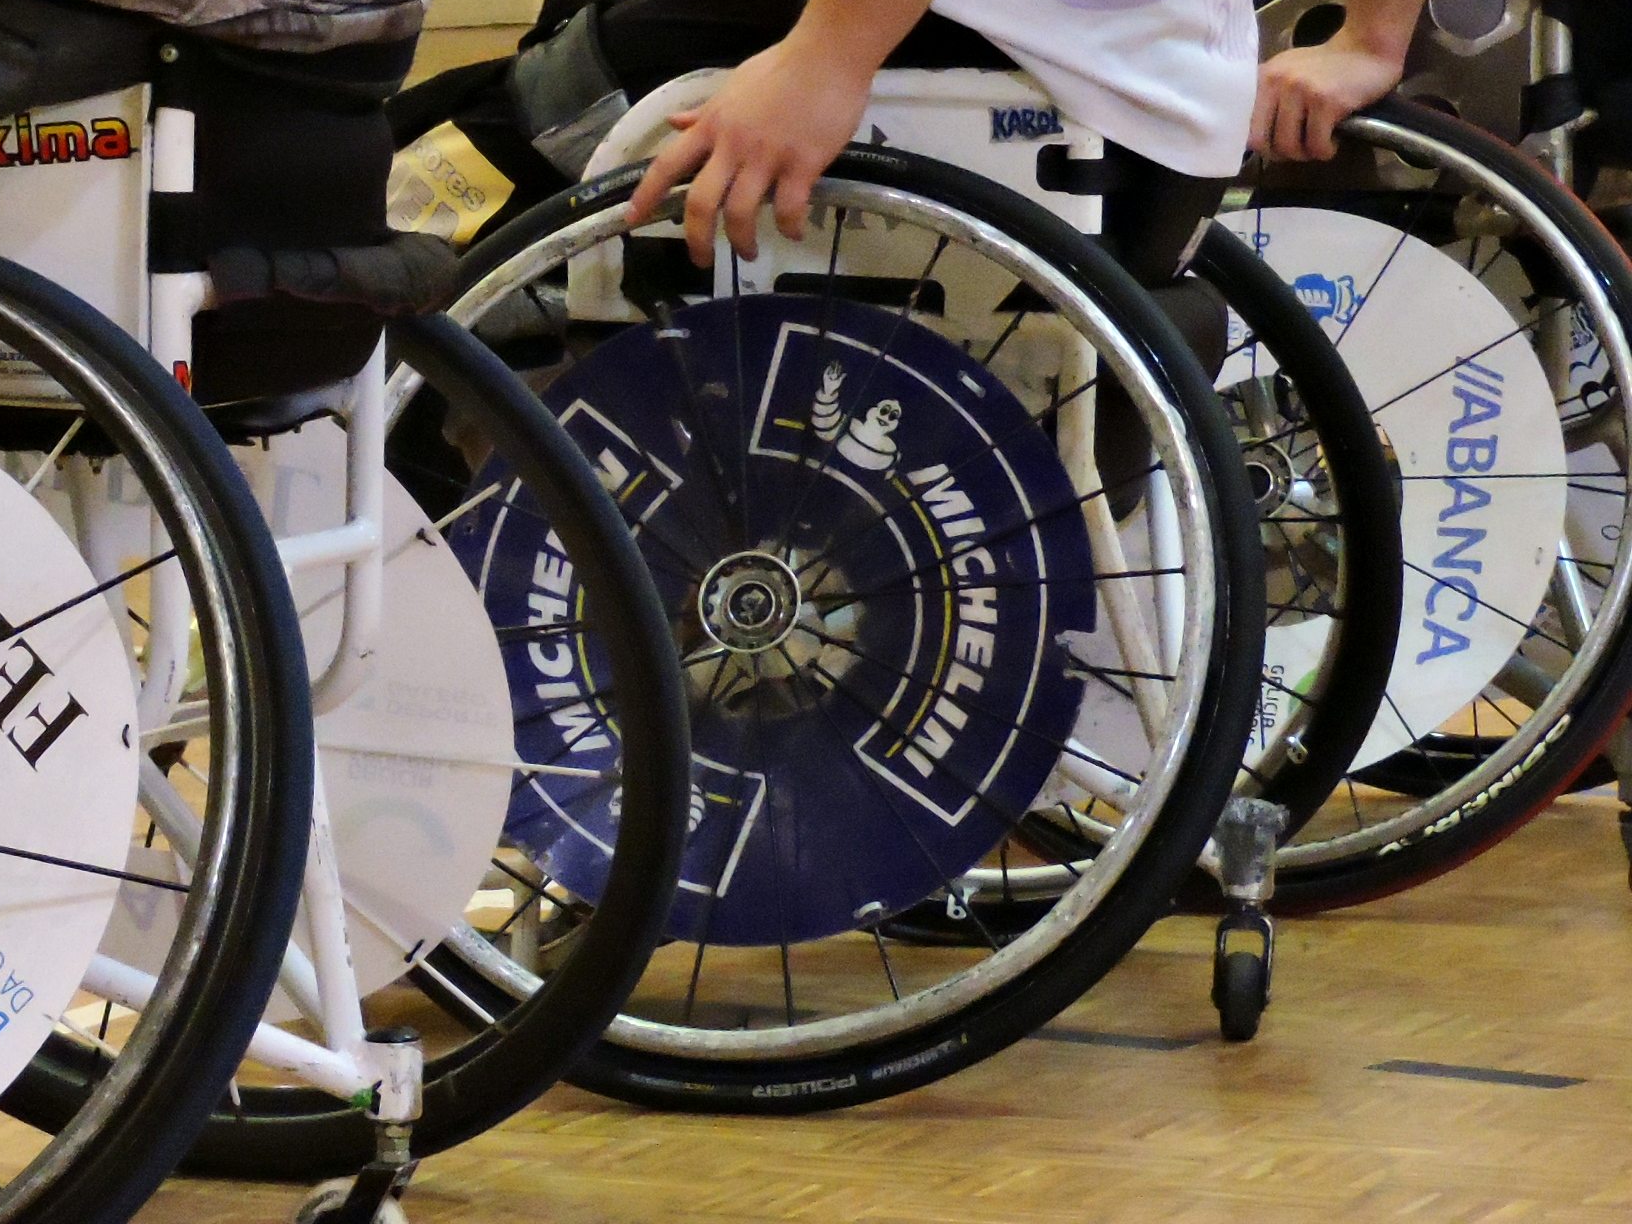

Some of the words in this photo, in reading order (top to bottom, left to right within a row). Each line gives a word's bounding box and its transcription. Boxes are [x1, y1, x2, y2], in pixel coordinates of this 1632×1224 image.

[903, 463, 998, 778] MICHELIN
[1416, 366, 1502, 666] ABANCA
[0, 970, 34, 1014] DA
